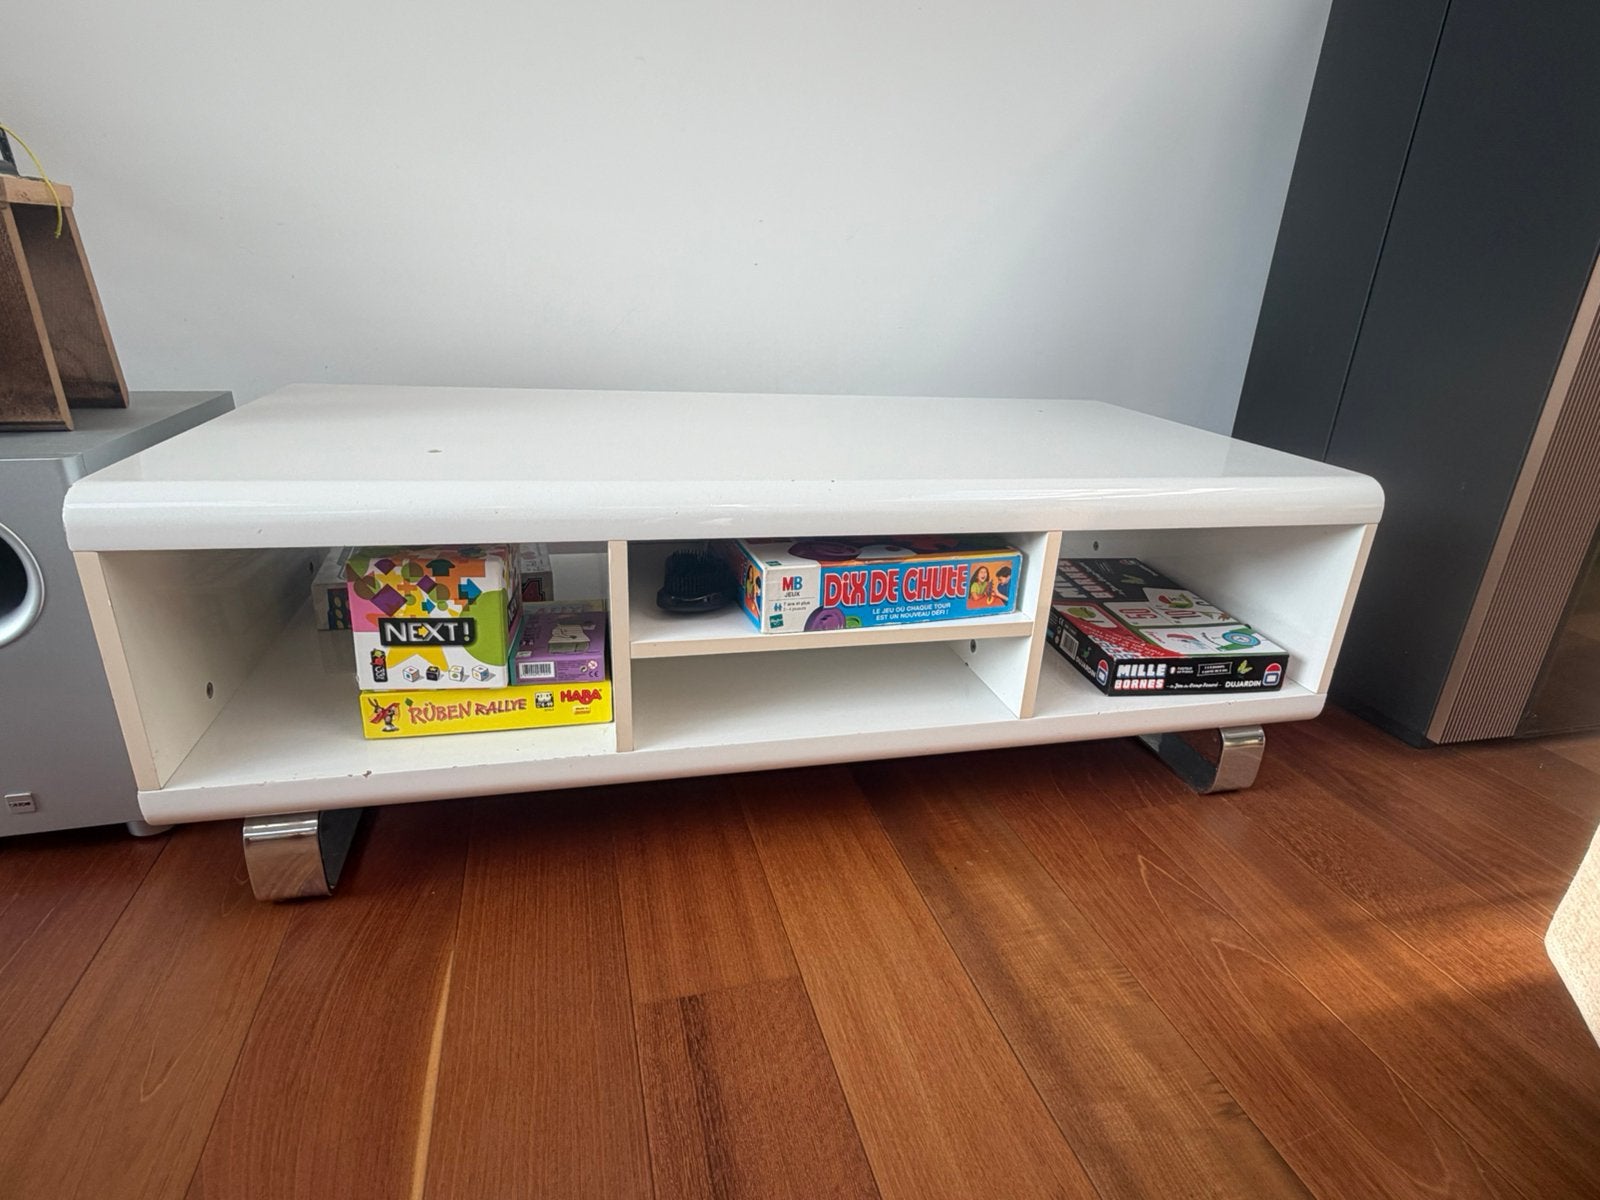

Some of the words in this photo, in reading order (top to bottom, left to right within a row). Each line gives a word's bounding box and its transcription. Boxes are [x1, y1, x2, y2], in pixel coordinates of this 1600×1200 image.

[782, 576, 803, 591] MB
[869, 569, 899, 605] DE
[900, 611, 930, 619] NOUVEAU
[906, 604, 933, 612] CHAQUE
[1117, 663, 1167, 678] MILLE
[1114, 679, 1165, 690] BORNES
[1225, 680, 1261, 688] DUJARDIN
[560, 688, 602, 705] HABA
[408, 701, 472, 725] RÜBEN
[474, 698, 527, 716] RALLYE
